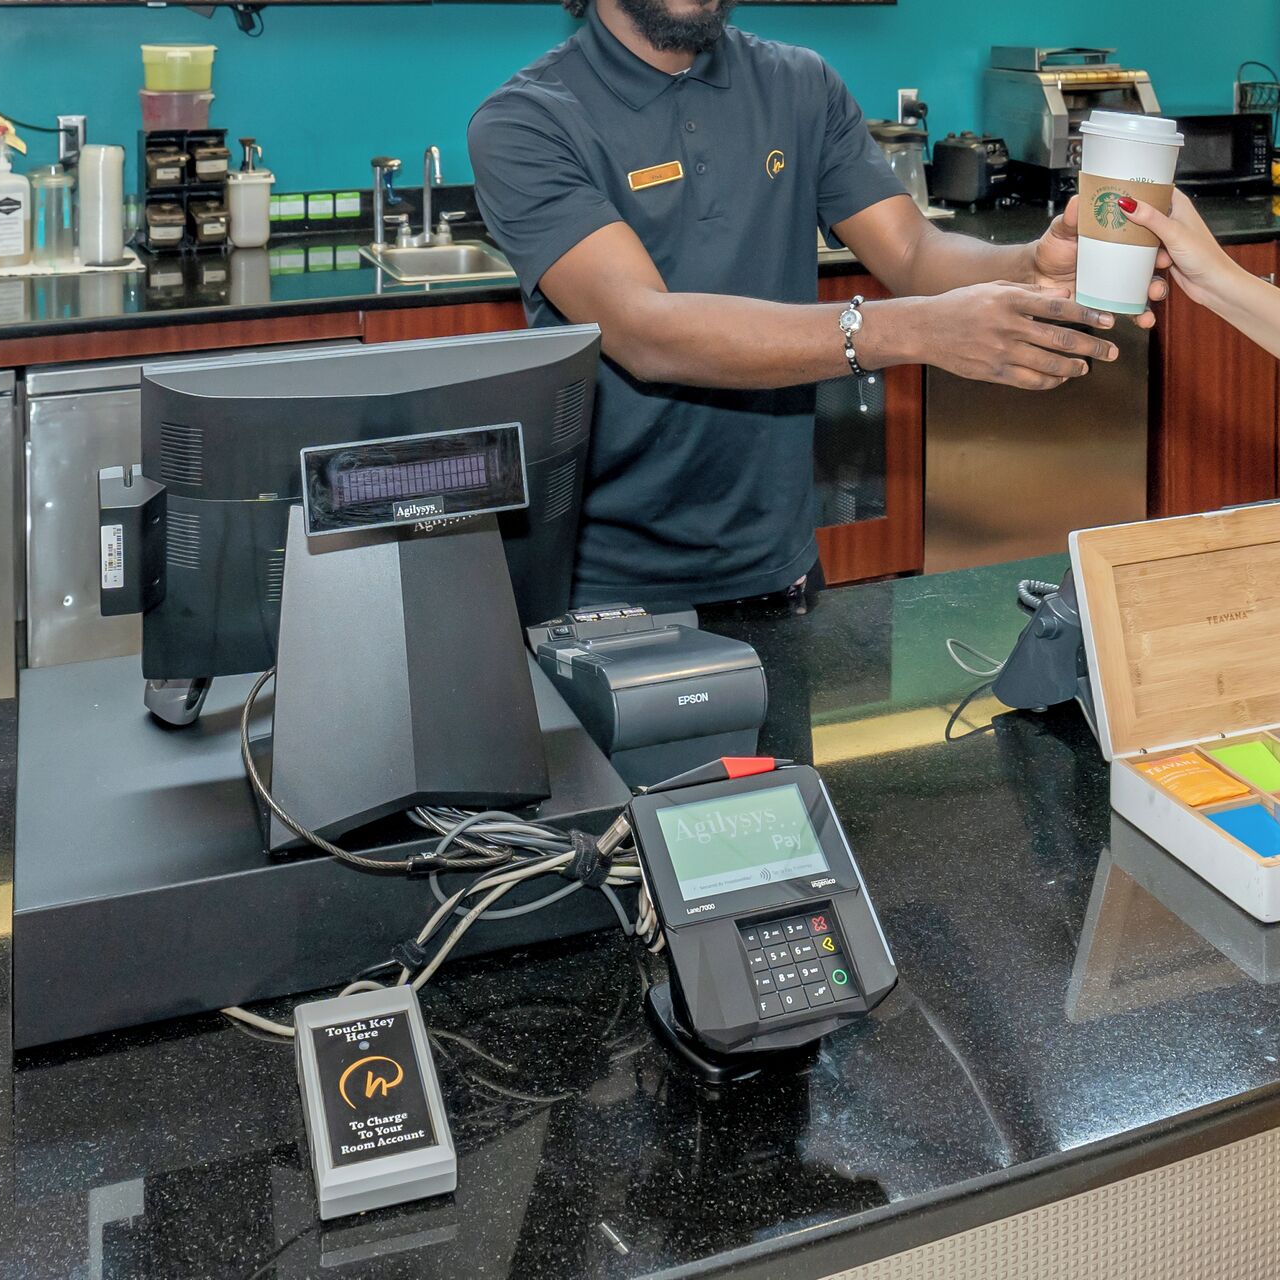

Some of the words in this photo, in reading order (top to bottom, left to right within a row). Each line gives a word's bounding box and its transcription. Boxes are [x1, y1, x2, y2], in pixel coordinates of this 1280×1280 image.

[396, 504, 436, 518] Agilysys
[1206, 611, 1248, 625] TEAVANA
[678, 692, 709, 706] EPSON
[674, 807, 776, 844] Agilysys
[773, 832, 802, 850] Pay
[686, 903, 716, 915] Lane/7000
[763, 931, 770, 939] 2
[787, 926, 794, 934] 3
[795, 947, 801, 955] 6
[779, 974, 785, 982] 8
[761, 1003, 766, 1011] F
[786, 996, 793, 1004] 0
[325, 1022, 367, 1038] Touch
[369, 1018, 395, 1031] Key
[346, 1029, 379, 1043] Here
[349, 1121, 365, 1131] To
[366, 1112, 408, 1127] Charge
[358, 1131, 374, 1140] To
[375, 1123, 404, 1136] Your
[341, 1141, 376, 1155] Room
[377, 1130, 425, 1147] Account
